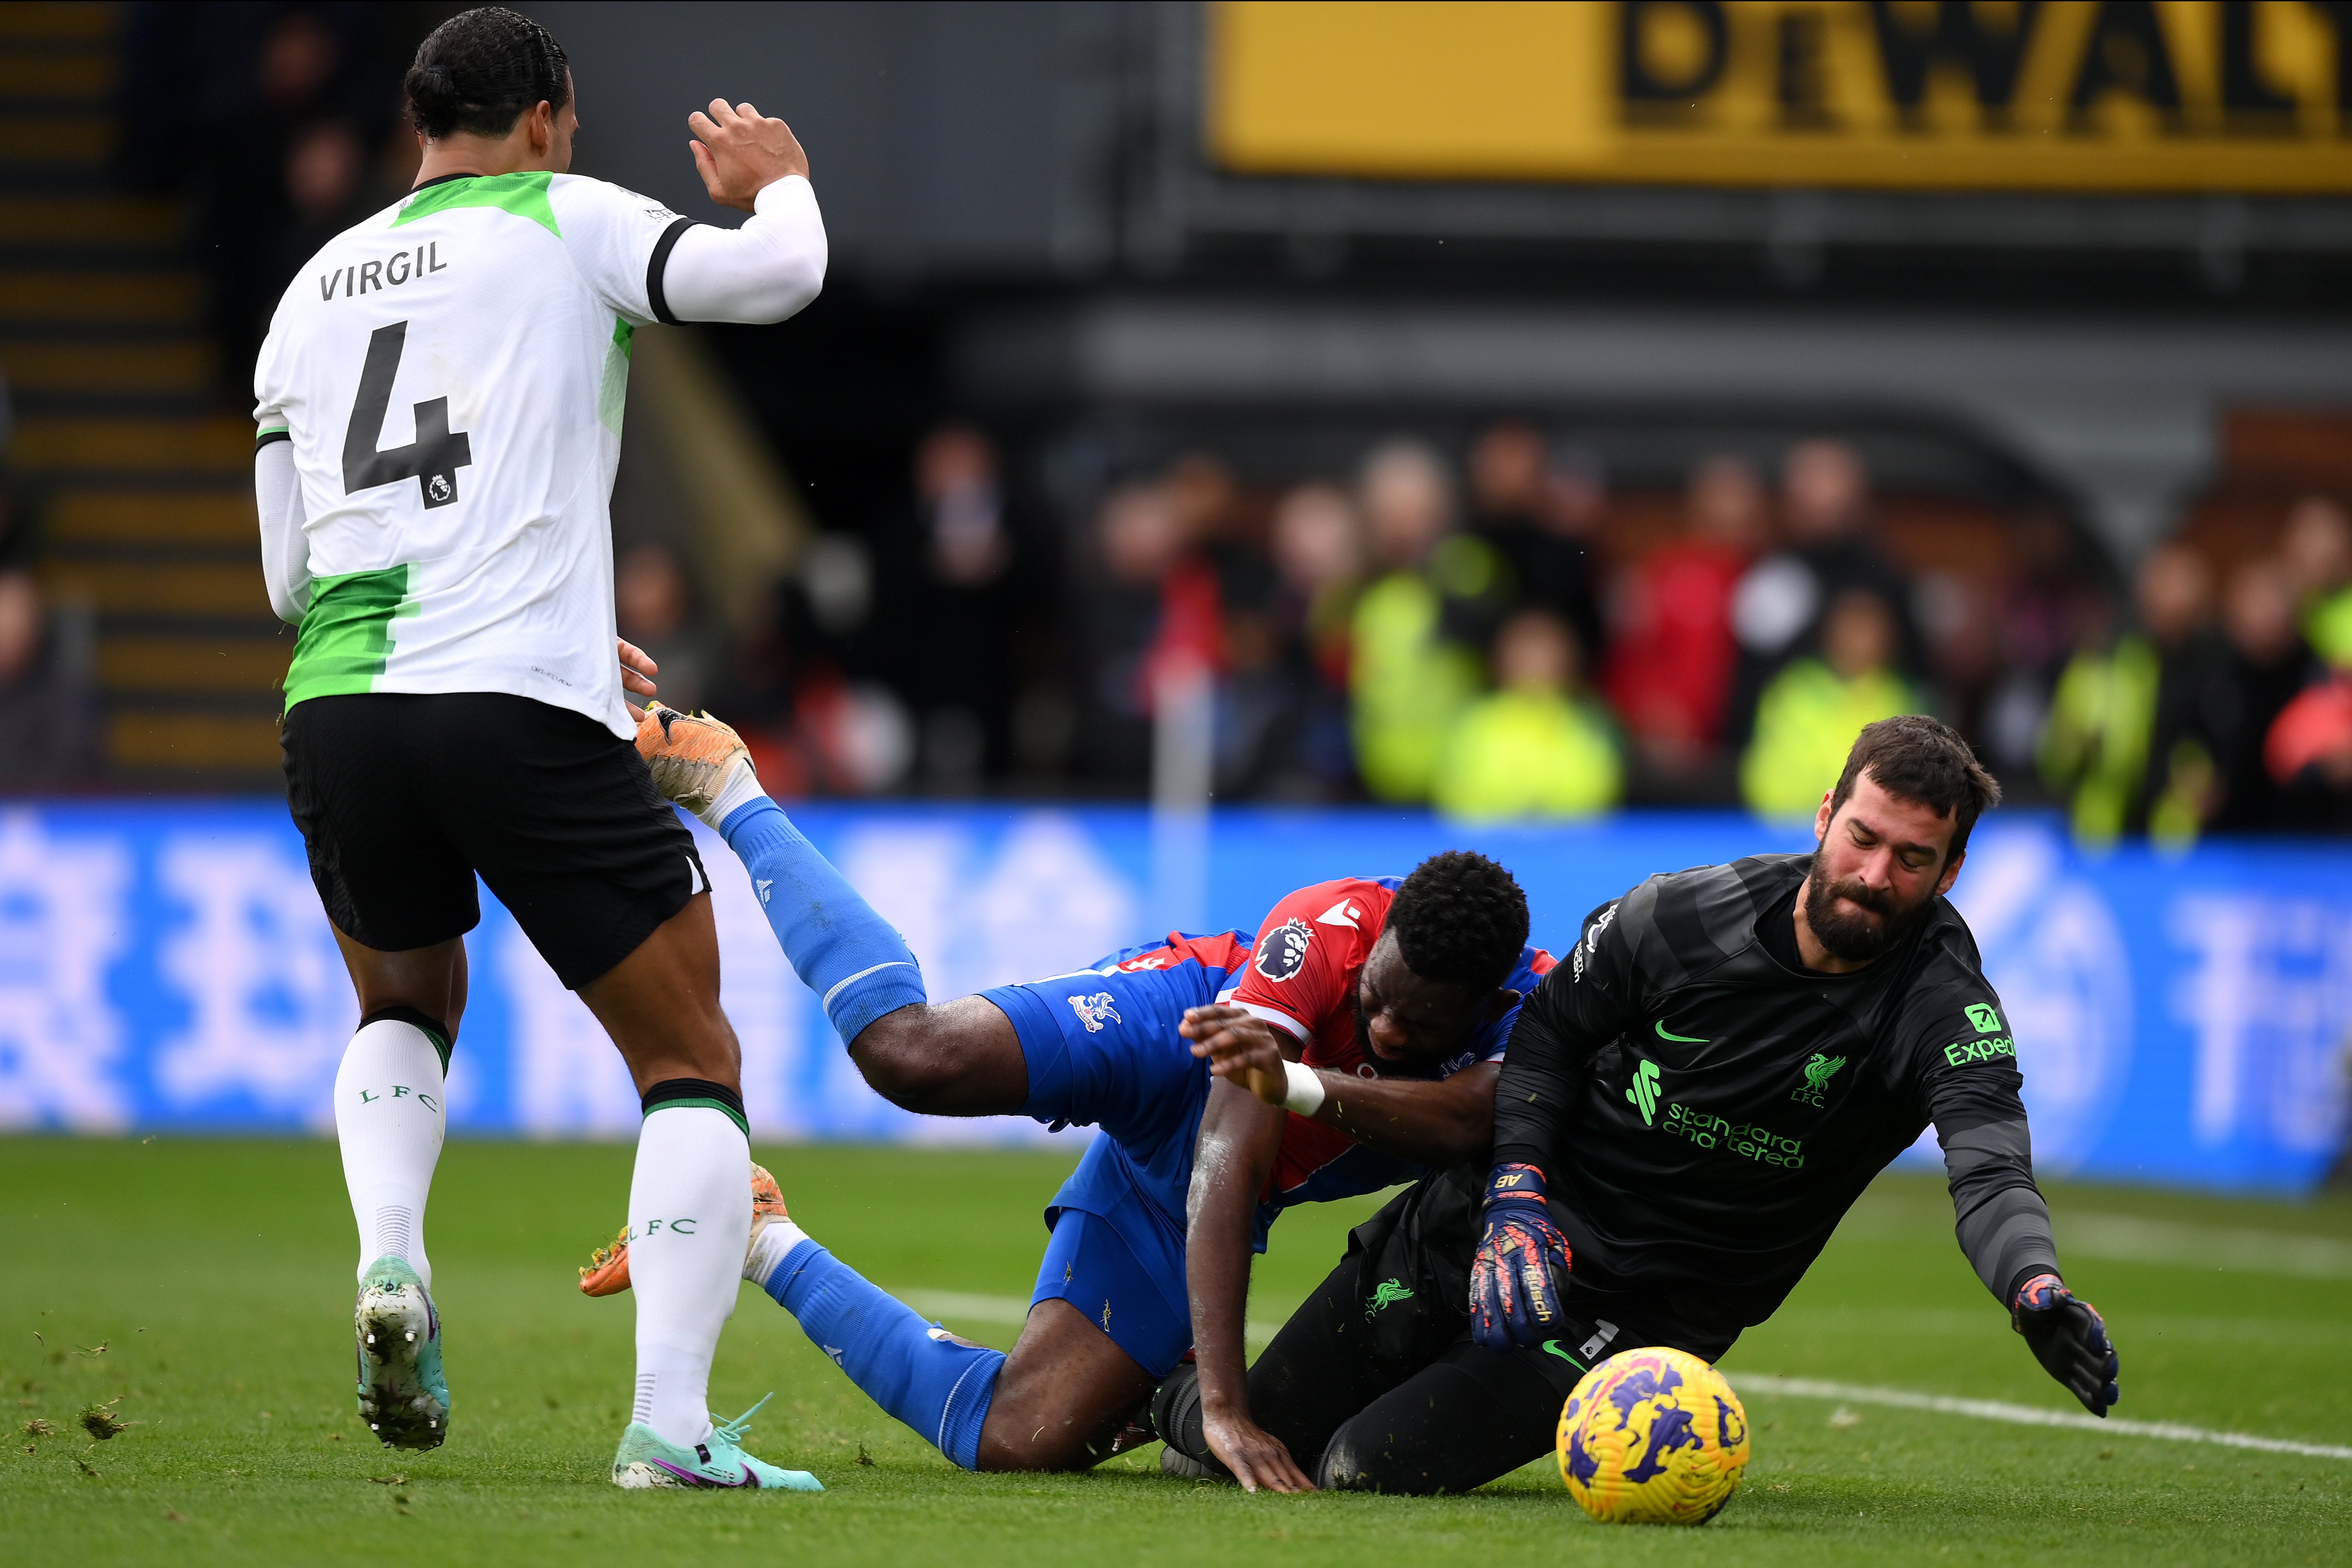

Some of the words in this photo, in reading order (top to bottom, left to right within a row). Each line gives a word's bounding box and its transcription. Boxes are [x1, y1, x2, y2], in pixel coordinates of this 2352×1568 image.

[320, 241, 447, 302] VIRGIL
[341, 319, 473, 511] 4
[1944, 1035, 2016, 1067] Exped
[1790, 1091, 1824, 1109] L.F.C.
[1668, 1103, 1801, 1155] standard
[1494, 1174, 1523, 1189] AB
[1524, 1264, 1553, 1322] reusch
